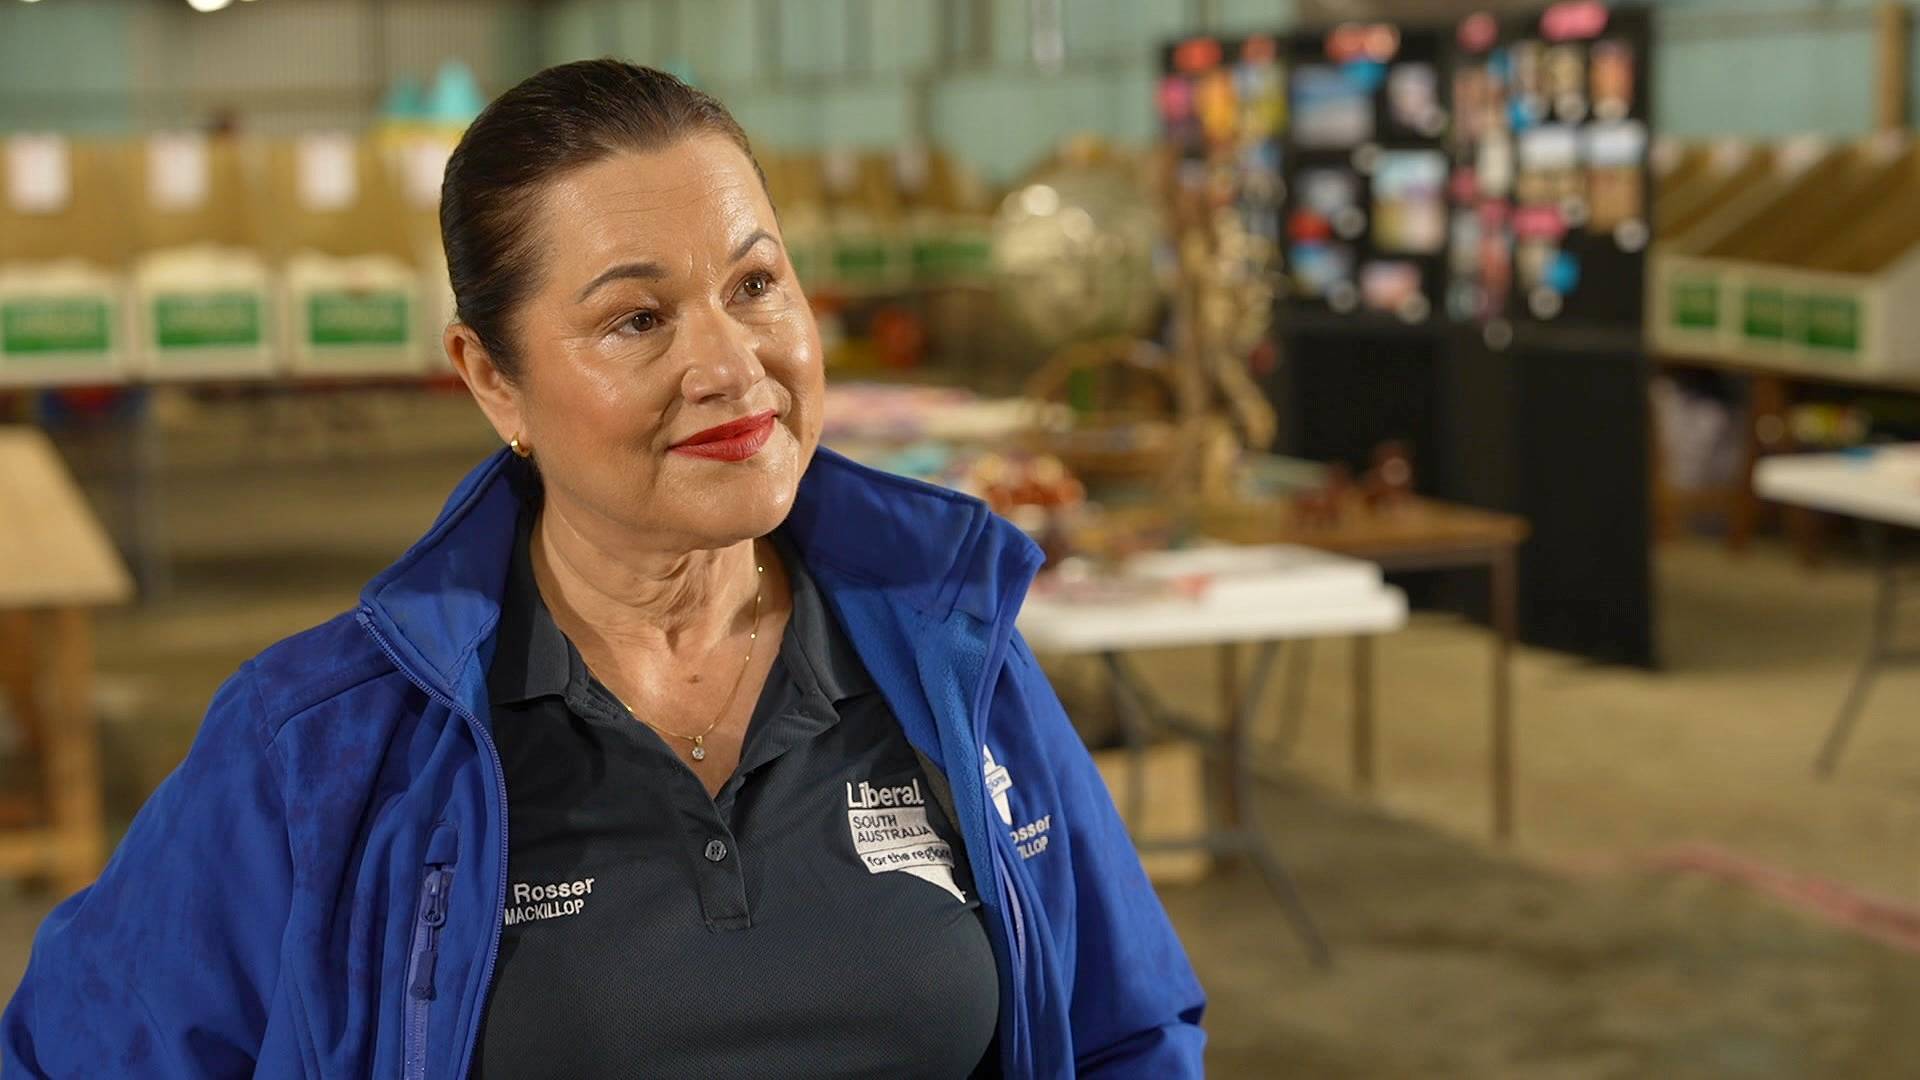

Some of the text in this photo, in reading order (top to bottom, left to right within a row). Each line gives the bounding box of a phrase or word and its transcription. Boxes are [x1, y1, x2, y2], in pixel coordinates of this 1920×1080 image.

[846, 778, 925, 808] Liberal
[853, 814, 898, 829] SOUTH
[858, 826, 931, 842] AUSTRALIA
[867, 855, 886, 867] for
[887, 852, 910, 863] the
[513, 877, 595, 904] Rosser
[504, 898, 585, 925] MACKILLOP
